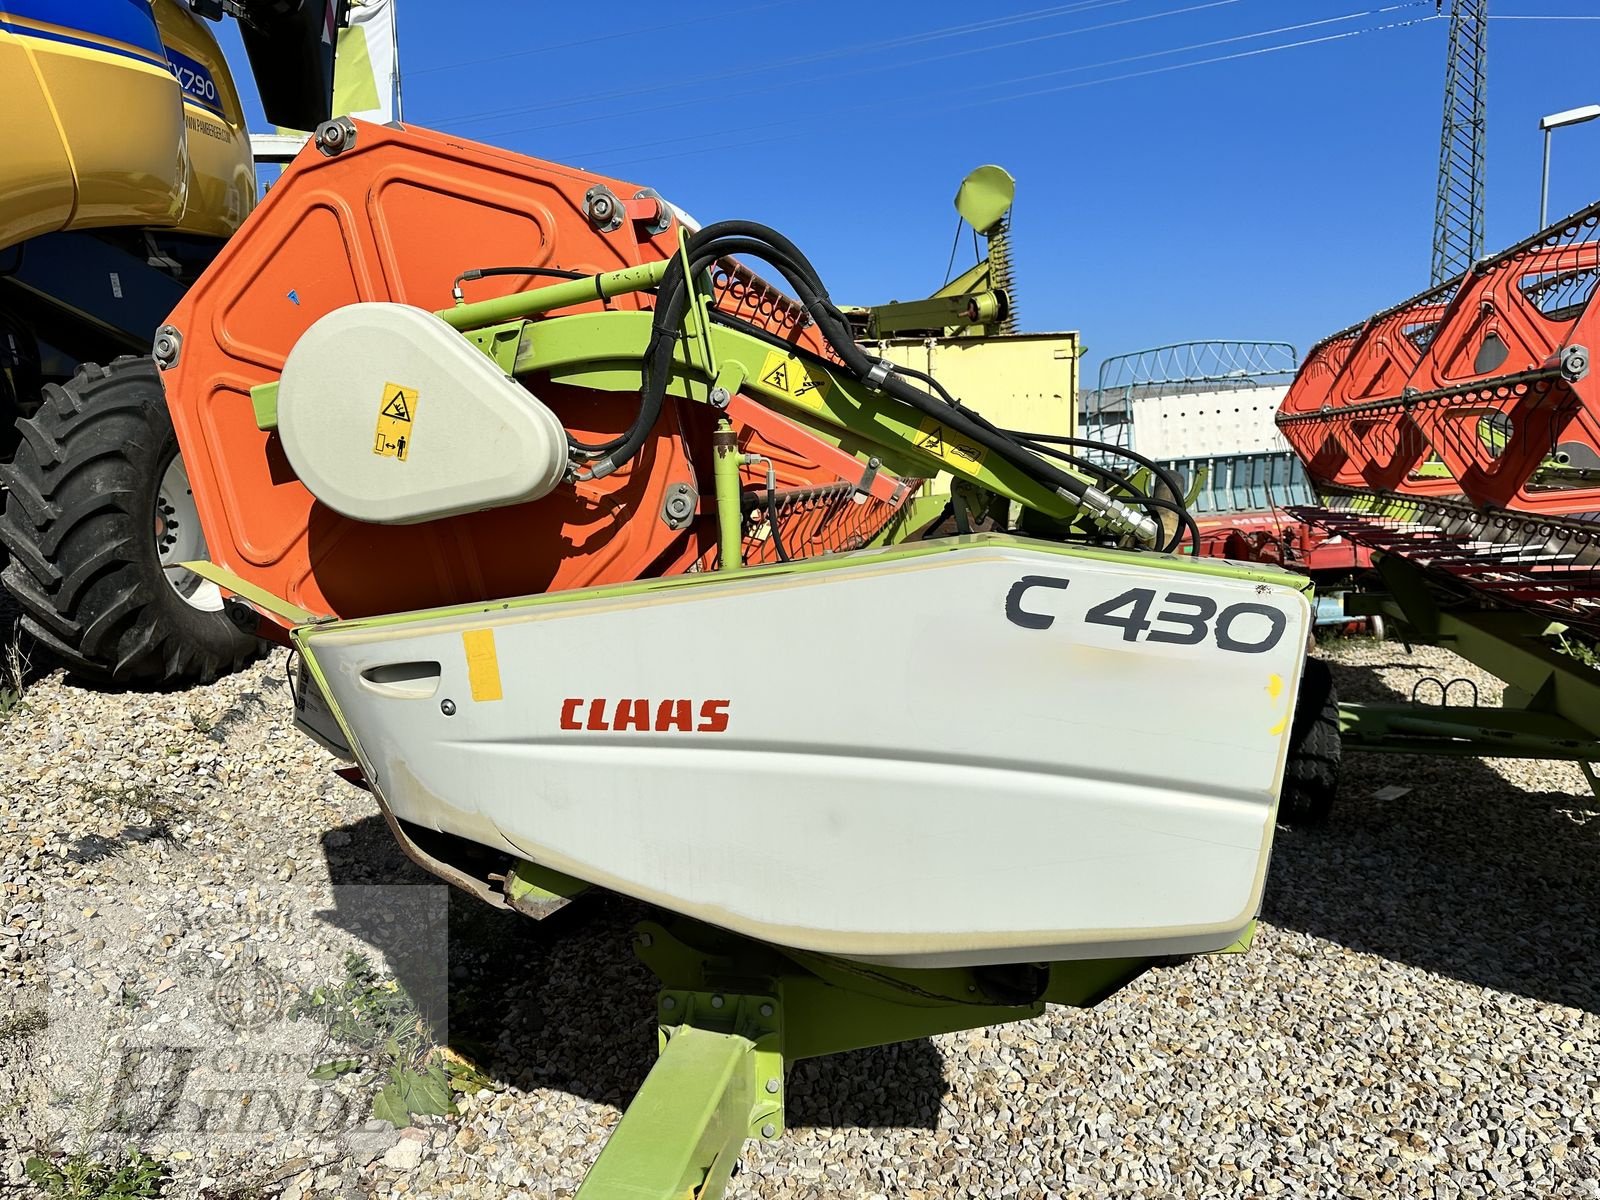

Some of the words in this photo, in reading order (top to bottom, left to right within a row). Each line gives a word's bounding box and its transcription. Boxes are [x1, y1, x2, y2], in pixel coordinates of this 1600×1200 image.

[167, 61, 215, 100] X7.90
[1005, 575, 1070, 630] C
[1084, 587, 1287, 654] 430
[560, 698, 730, 732] CLAAS
